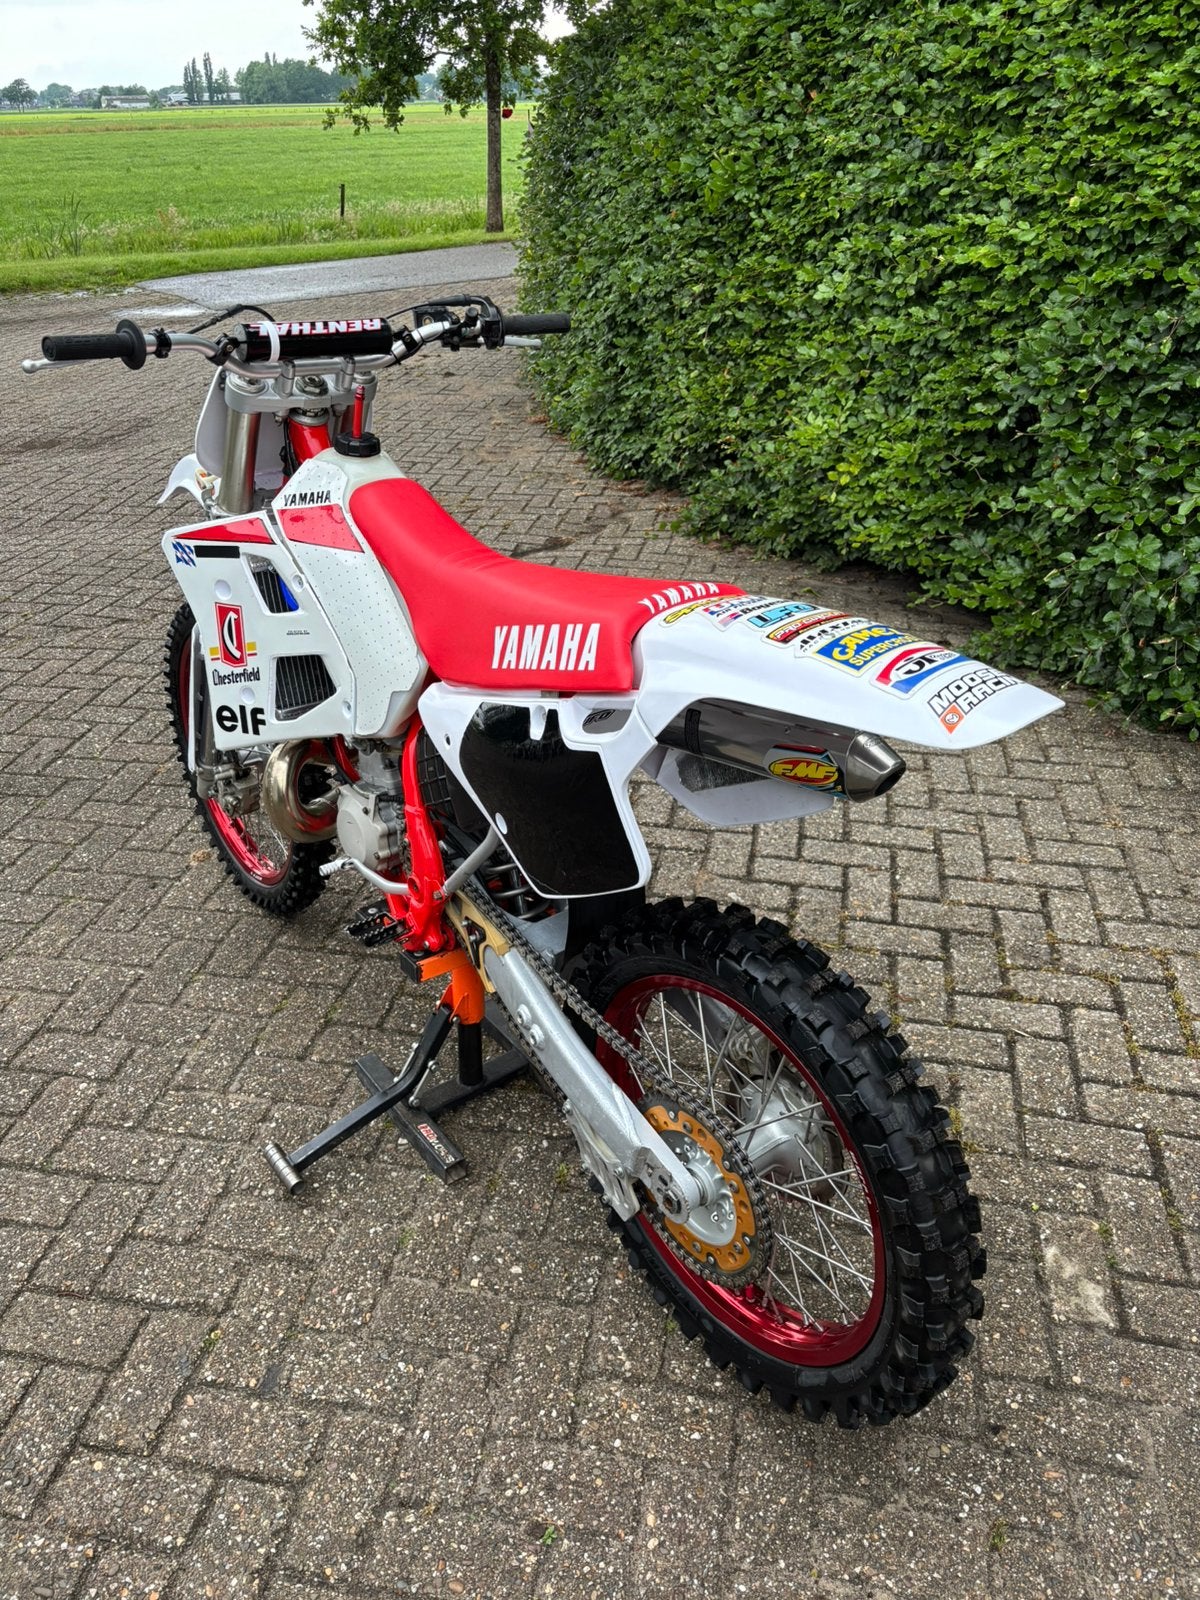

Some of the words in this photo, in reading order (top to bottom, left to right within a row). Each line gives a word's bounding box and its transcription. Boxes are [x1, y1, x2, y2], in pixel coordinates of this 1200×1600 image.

[251, 318, 382, 337] RENTHAL
[283, 489, 332, 507] YAMAHA
[636, 582, 720, 615] YAMAHA
[491, 623, 600, 671] YAMAHA
[212, 667, 260, 686] Chesterfield
[954, 674, 1020, 715] RACIN
[216, 704, 267, 736] elf
[773, 762, 838, 779] FMF
